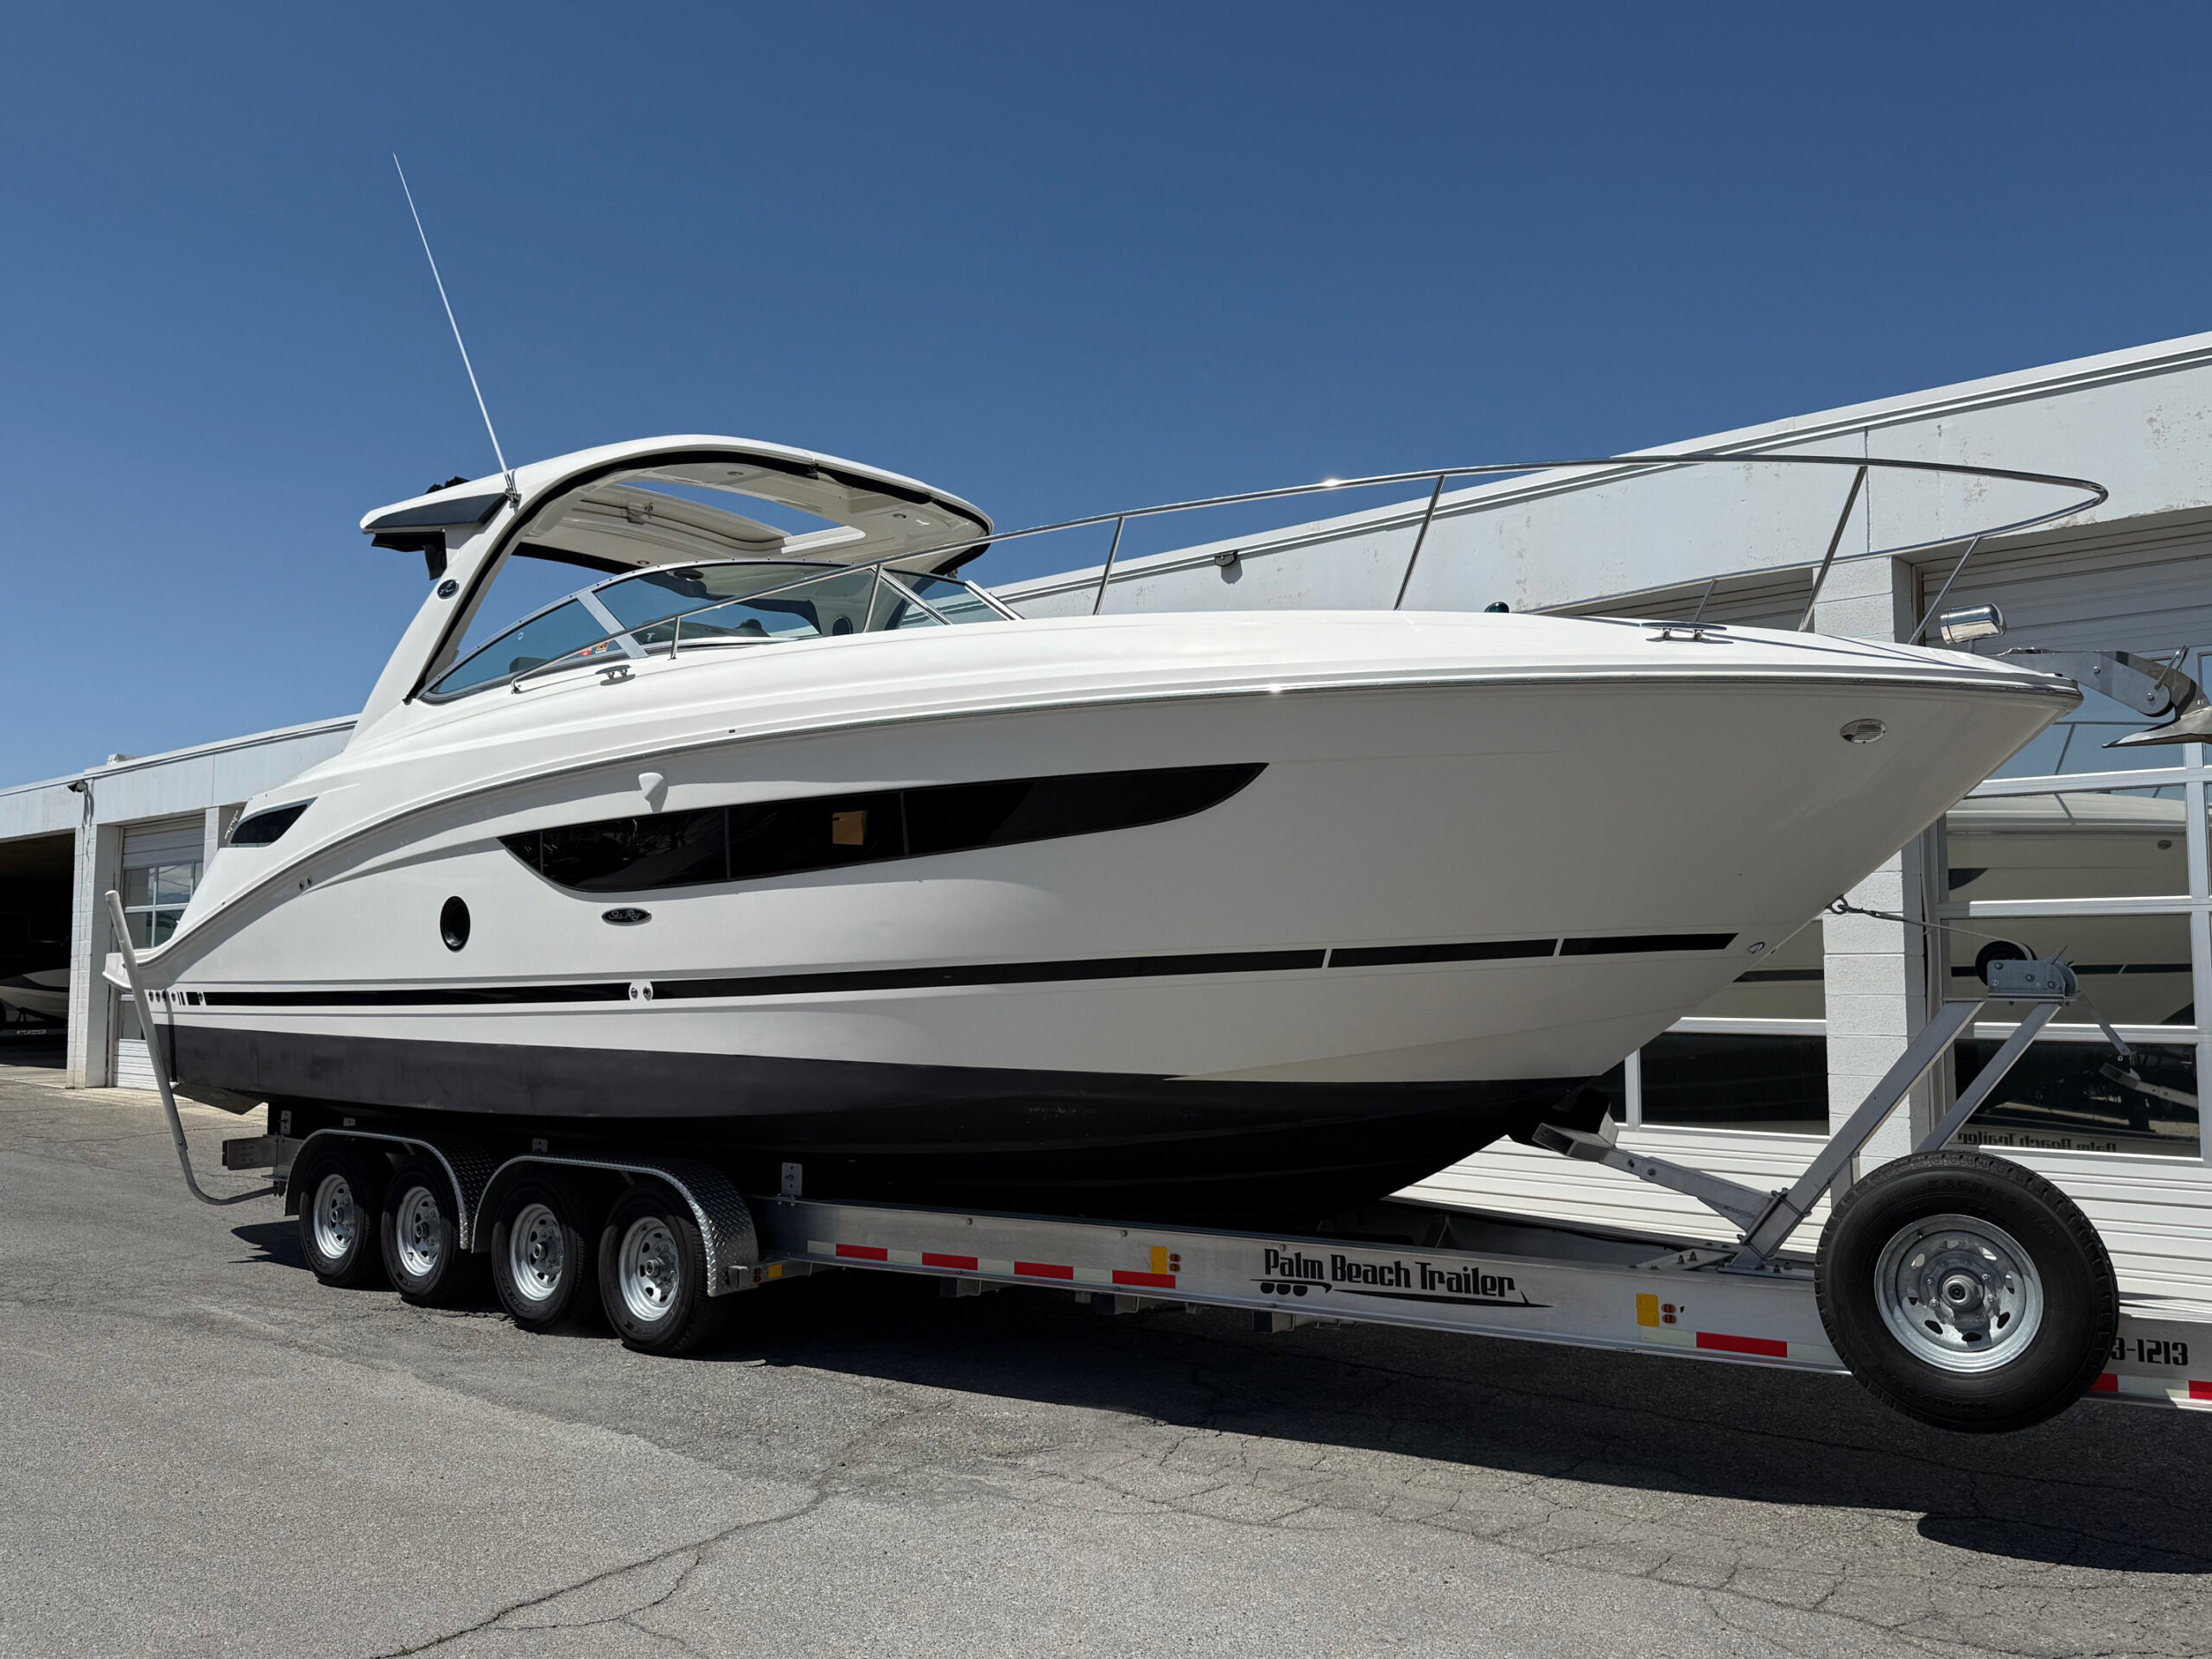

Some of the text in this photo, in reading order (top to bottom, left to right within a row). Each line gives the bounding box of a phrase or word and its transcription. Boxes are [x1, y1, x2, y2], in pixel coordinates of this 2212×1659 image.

[624, 909, 641, 921] Ray
[1264, 1249, 1515, 1298] Palm Beach Trailer
[2110, 1337, 2189, 1366] 3-1213
